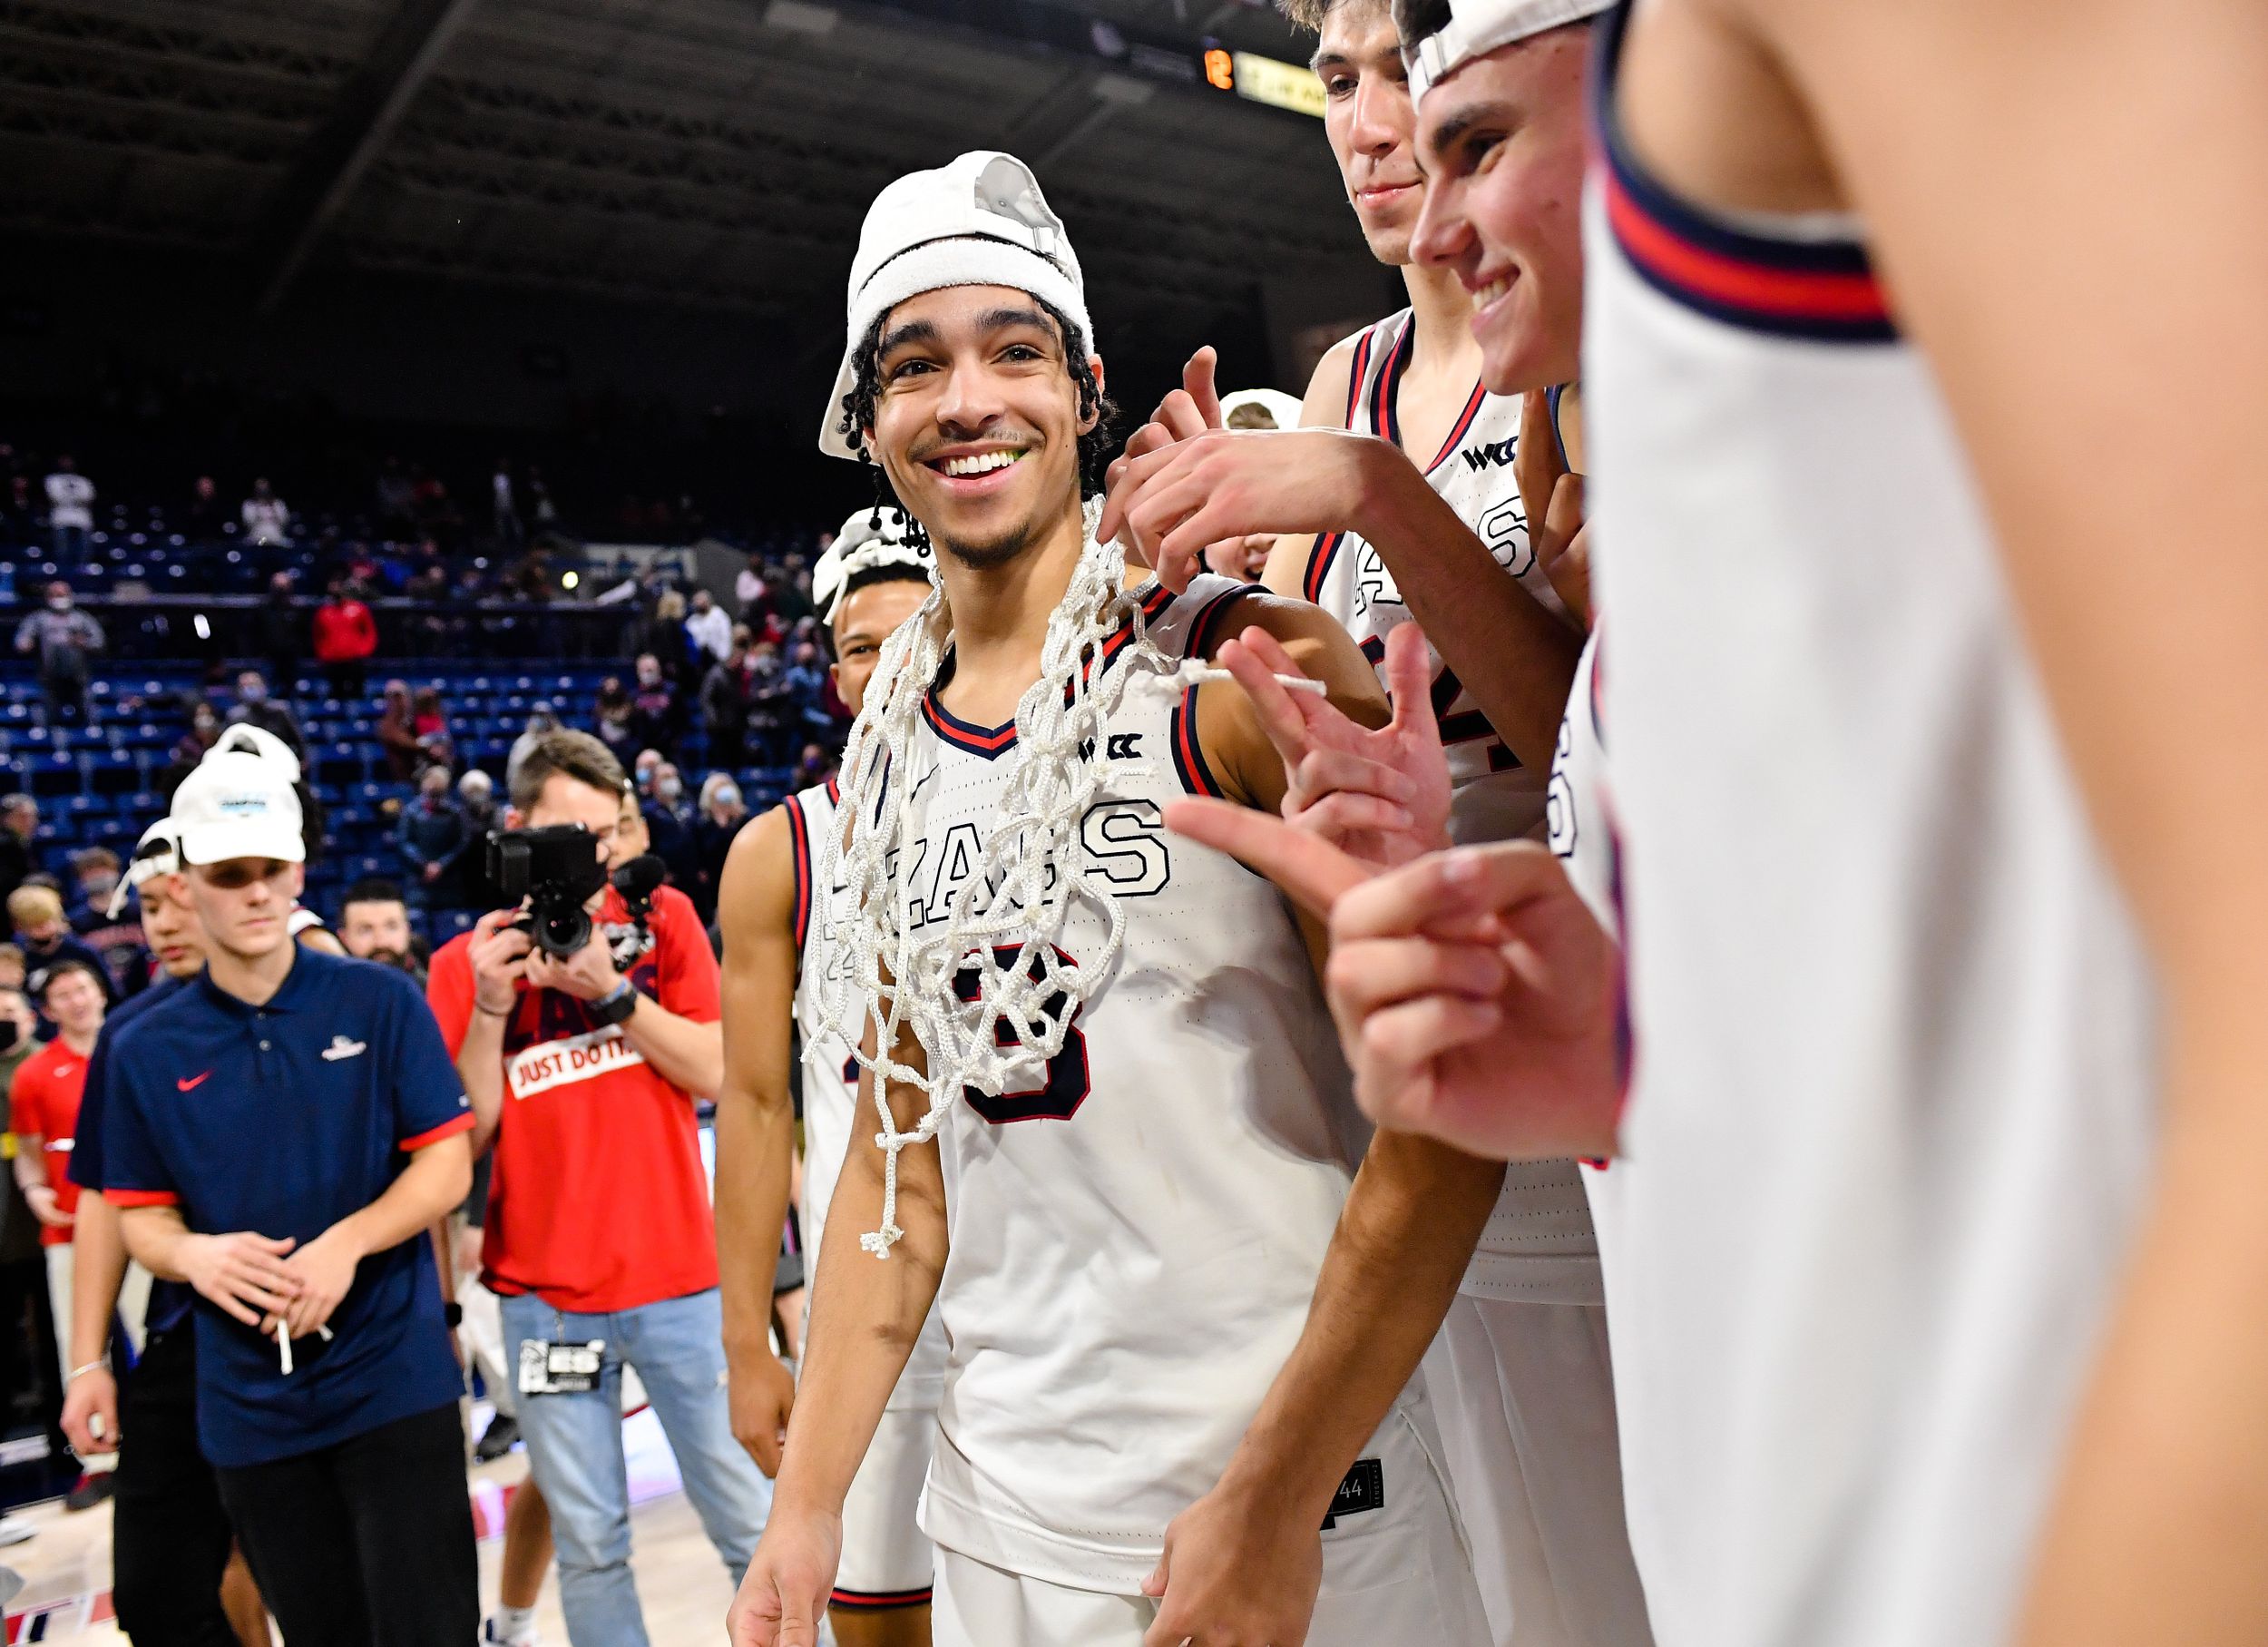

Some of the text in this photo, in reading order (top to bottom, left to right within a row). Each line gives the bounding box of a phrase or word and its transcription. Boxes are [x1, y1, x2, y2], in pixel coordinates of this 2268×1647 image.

[1078, 733, 1143, 764] WCC
[951, 942, 1091, 1125] 3
[519, 1054, 562, 1086] JUST
[570, 1044, 601, 1069] DO
[1339, 1478, 1363, 1498] 44
